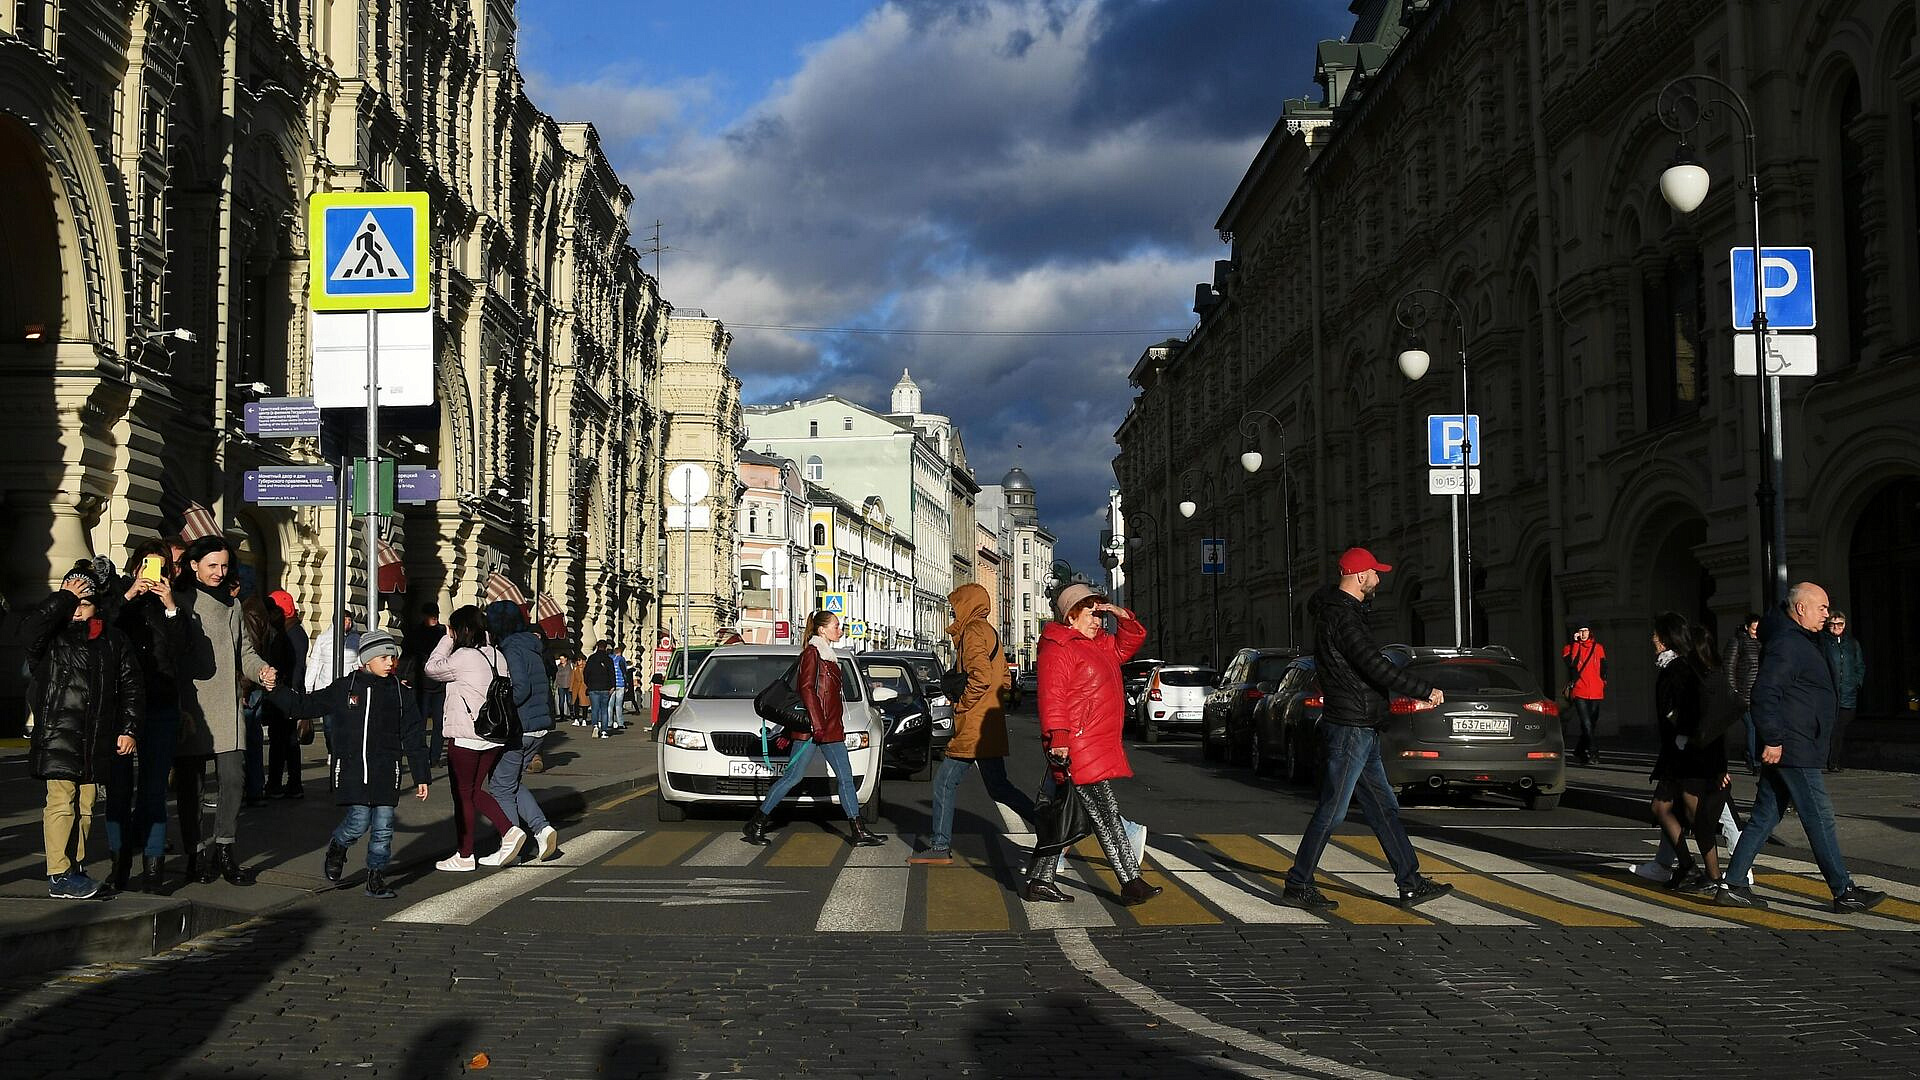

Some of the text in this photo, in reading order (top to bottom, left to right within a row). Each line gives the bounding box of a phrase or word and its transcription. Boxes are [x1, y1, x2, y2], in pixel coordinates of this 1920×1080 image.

[1760, 257, 1798, 313] P
[1443, 421, 1466, 460] P
[1446, 478, 1455, 486] 15
